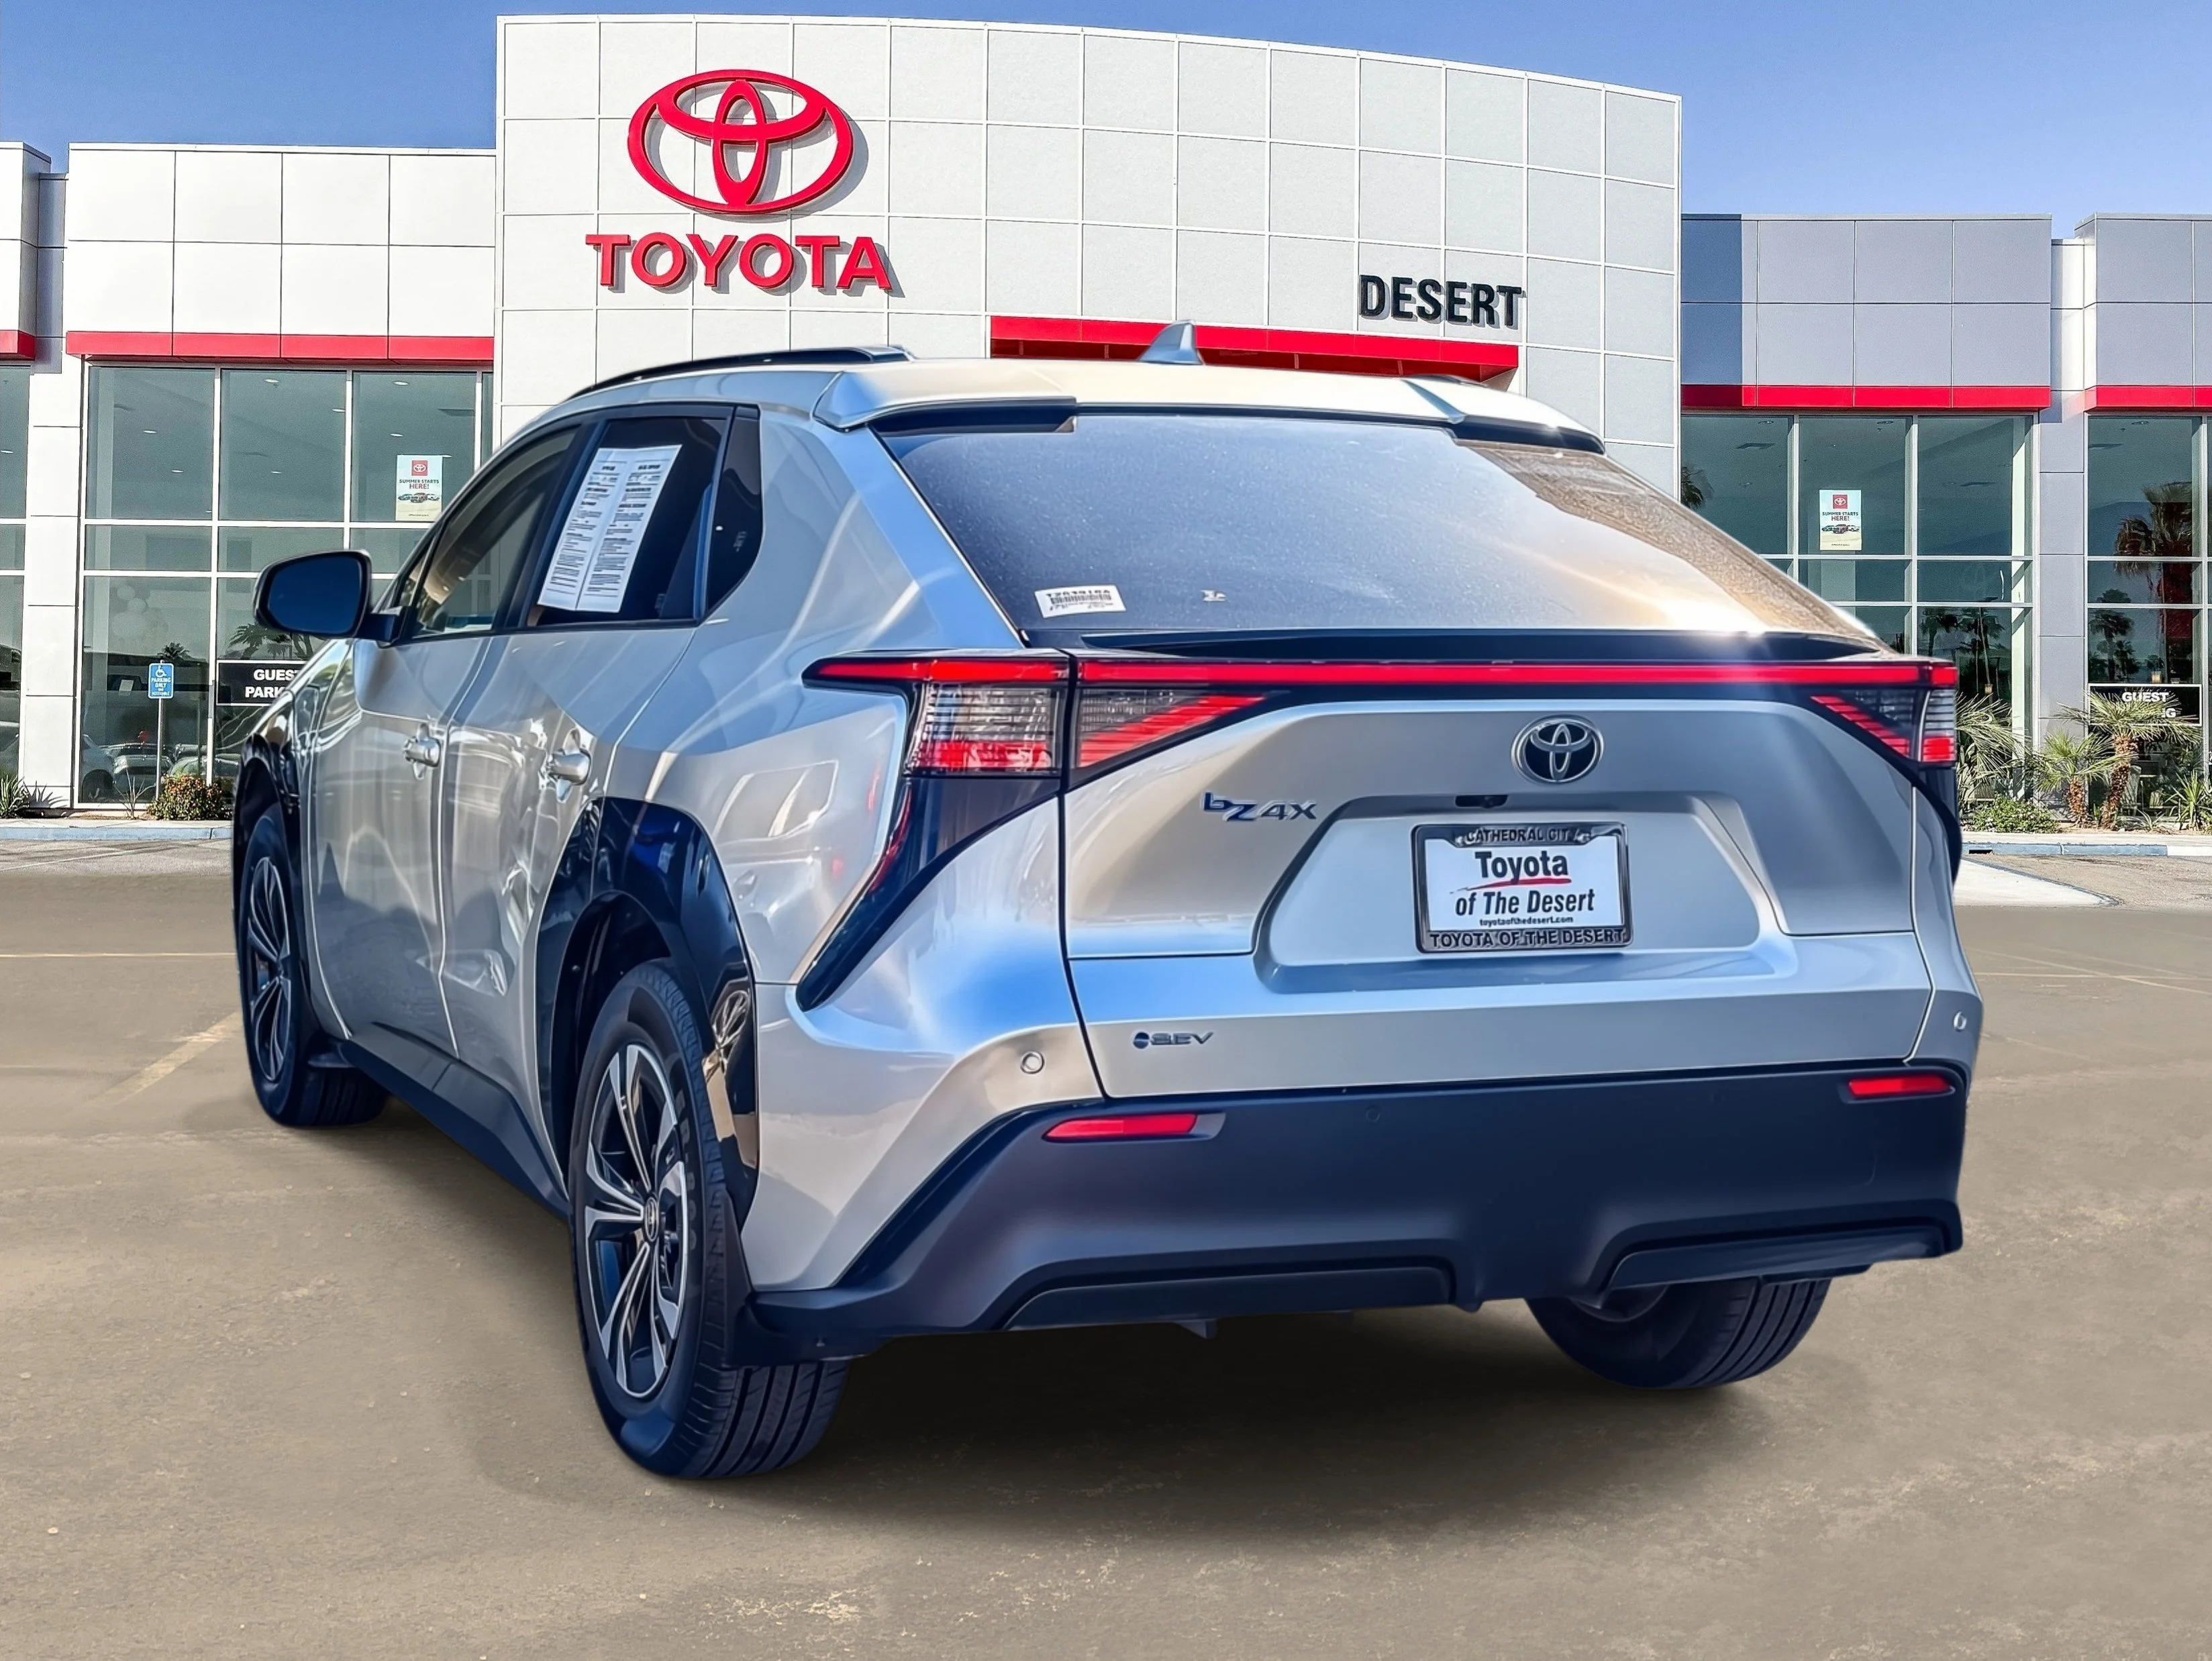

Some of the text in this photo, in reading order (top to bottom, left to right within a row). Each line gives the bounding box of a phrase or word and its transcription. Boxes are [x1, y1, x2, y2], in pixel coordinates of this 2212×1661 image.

[585, 233, 892, 291] TOYOTA
[1359, 274, 1522, 326] DESERT
[245, 686, 287, 698] PARK
[1467, 829, 1543, 843] CATHEDRAL
[1474, 850, 1569, 885] Toyota
[1455, 889, 1595, 916] of The Desert
[1479, 917, 1574, 928] toyotaofthedesert.com
[1431, 928, 1624, 948] TOYOTA OF THE DESERT
